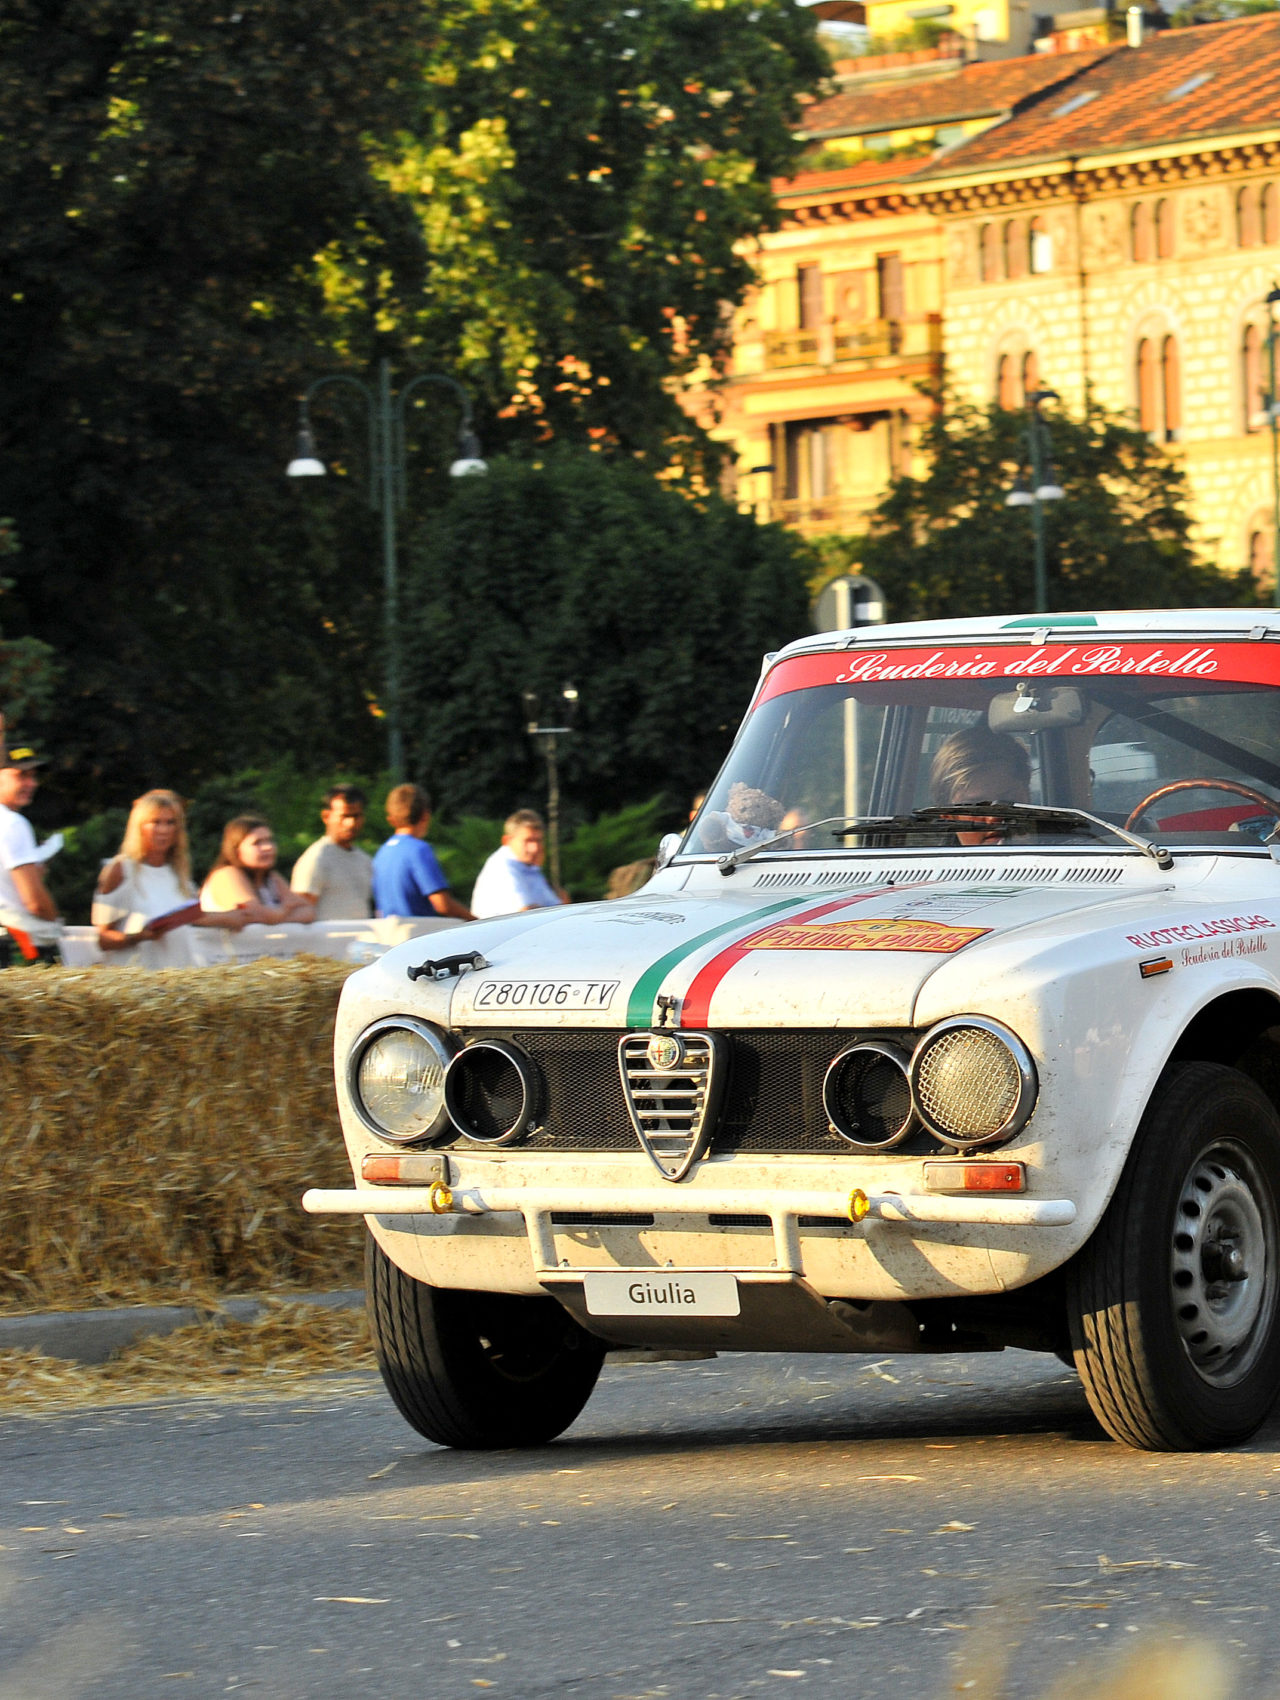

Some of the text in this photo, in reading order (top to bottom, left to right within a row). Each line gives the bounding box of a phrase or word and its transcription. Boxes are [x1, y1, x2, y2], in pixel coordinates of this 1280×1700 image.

[836, 646, 1219, 684] Scuderia del Portello
[749, 929, 866, 947] PEKING
[867, 931, 973, 949] PARIS
[1125, 914, 1277, 950] RUOTECLASSICHE
[1181, 935, 1268, 967] Scuderia del Portello
[478, 983, 617, 1006] 280106 TV
[628, 1283, 697, 1305] Giulia
